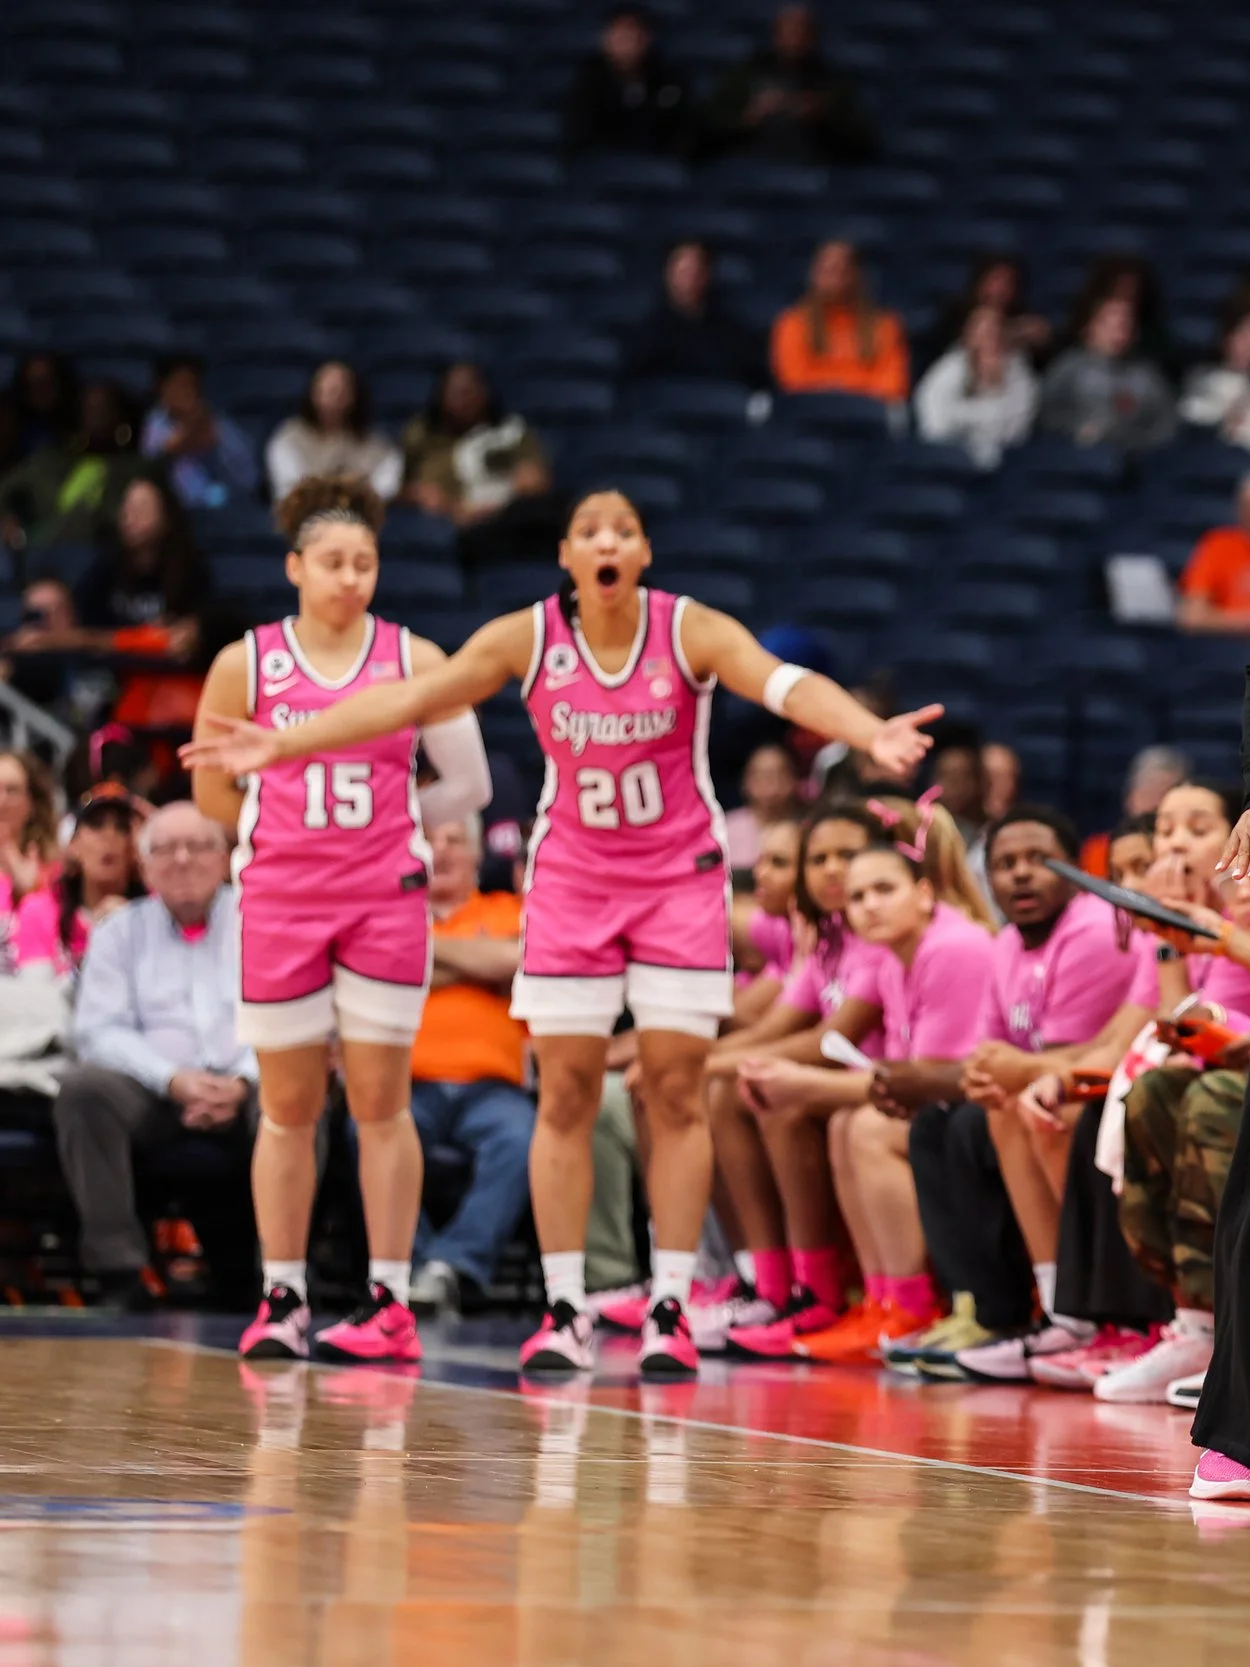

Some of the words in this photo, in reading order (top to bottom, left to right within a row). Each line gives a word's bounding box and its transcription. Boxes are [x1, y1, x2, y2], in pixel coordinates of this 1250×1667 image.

[550, 700, 677, 757] Syracuse
[303, 761, 373, 829] 15
[575, 760, 665, 829] 20
